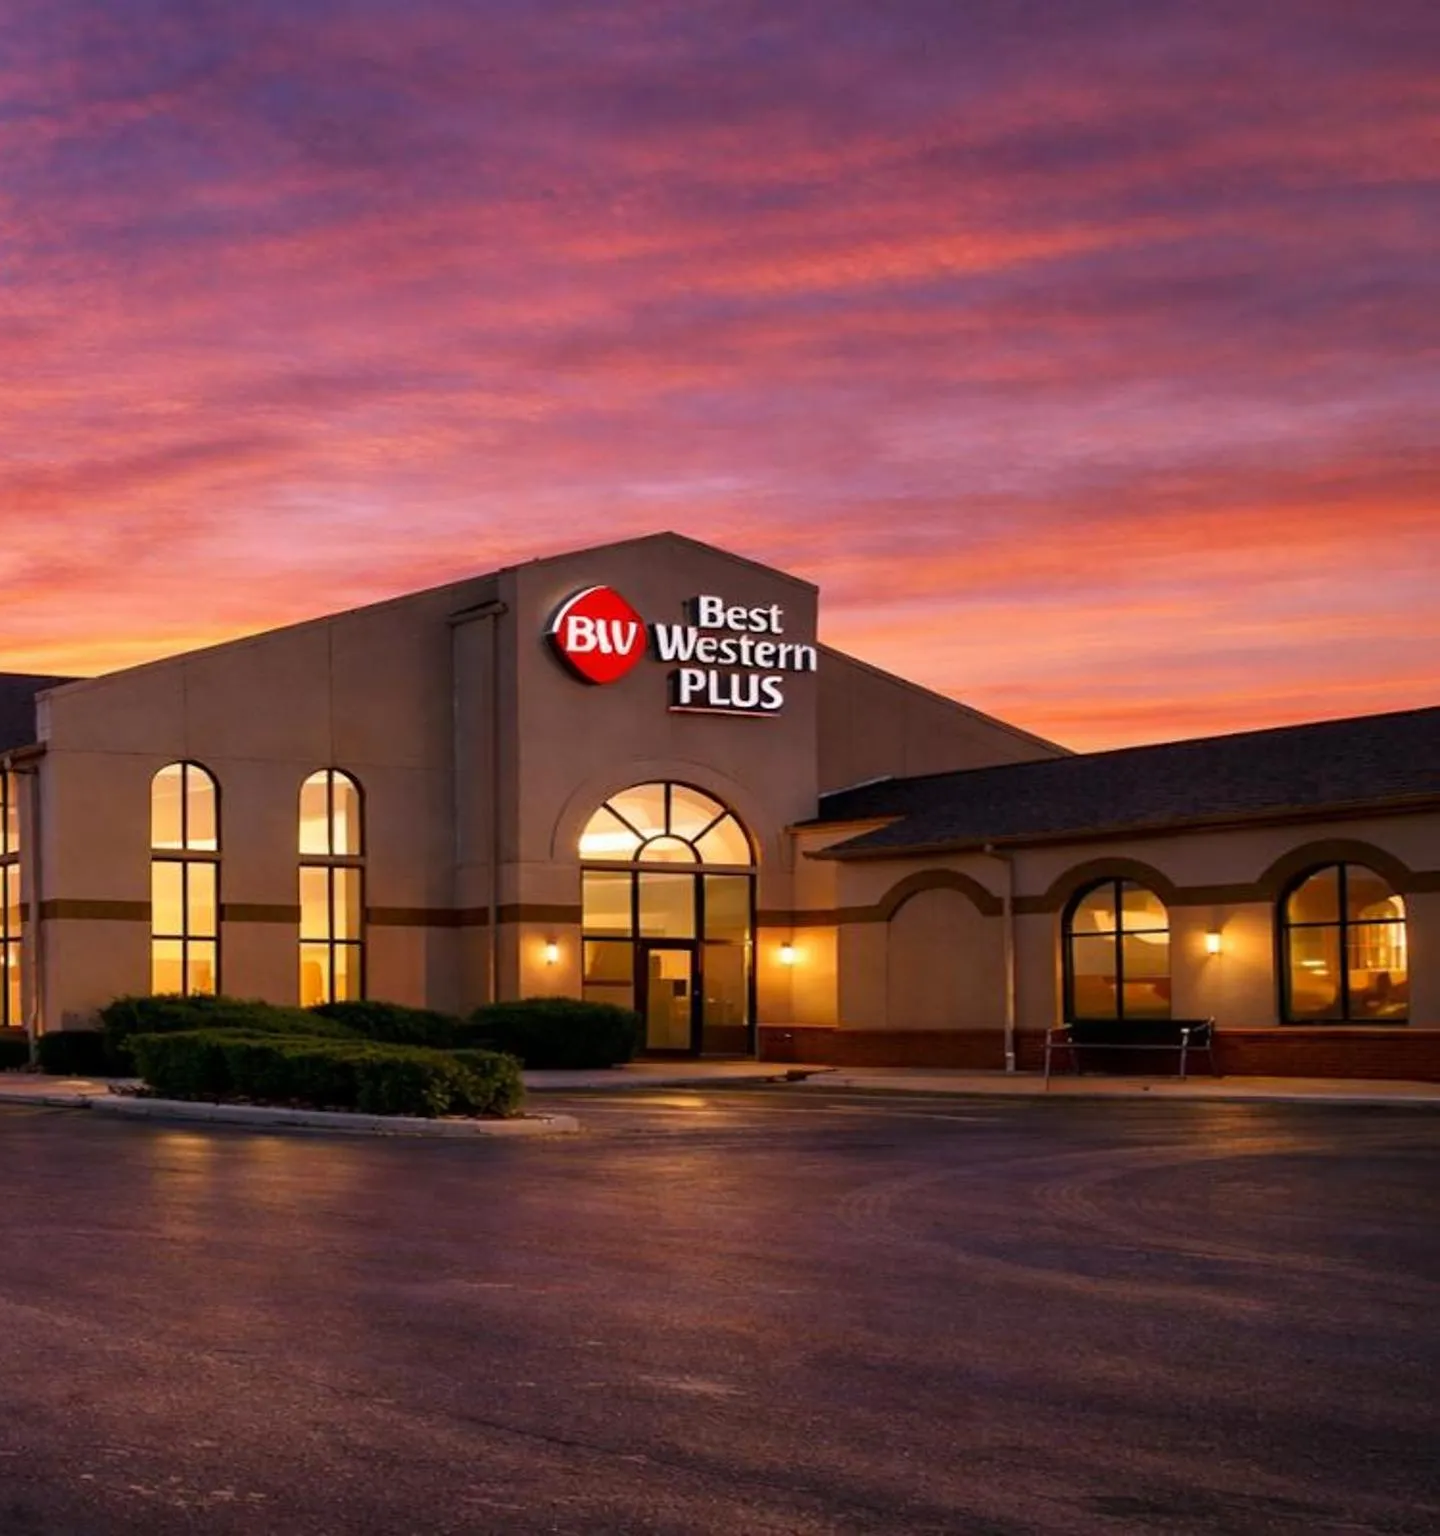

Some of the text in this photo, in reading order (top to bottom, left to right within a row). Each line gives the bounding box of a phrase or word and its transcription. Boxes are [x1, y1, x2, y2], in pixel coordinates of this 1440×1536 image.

[566, 615, 637, 655] BW
[698, 595, 784, 634] Best
[655, 623, 817, 672] Western
[679, 668, 785, 710] PLUS
